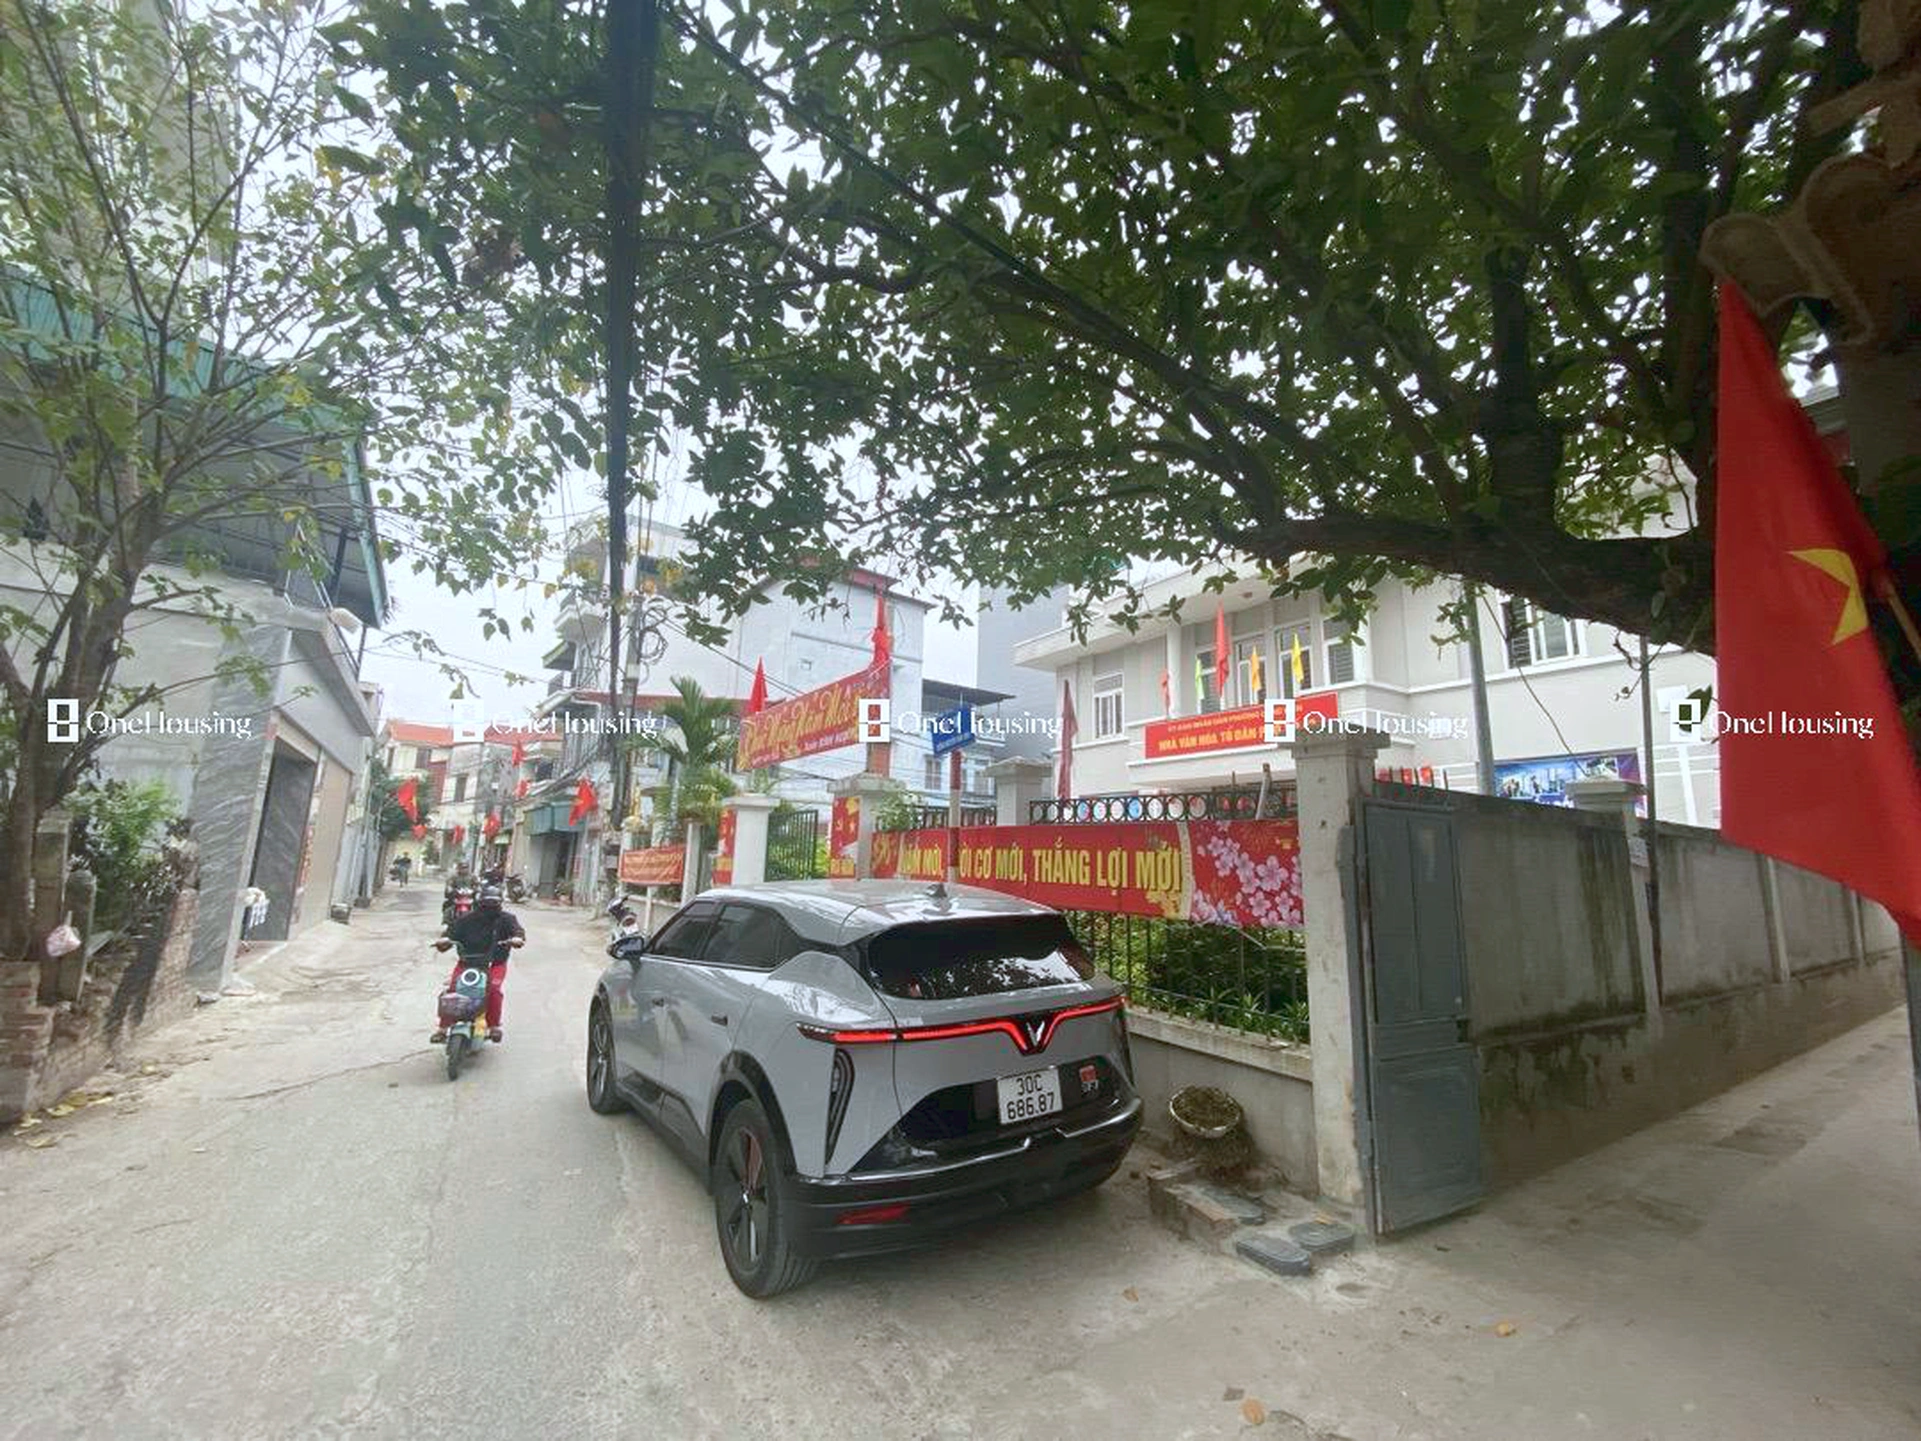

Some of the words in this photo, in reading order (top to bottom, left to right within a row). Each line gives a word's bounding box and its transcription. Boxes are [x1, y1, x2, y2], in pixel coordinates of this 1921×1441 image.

[975, 846, 994, 879] CƠ
[995, 841, 1028, 884] MỚI,
[1032, 836, 1091, 886] THẮNG
[1097, 846, 1128, 896] LỢI
[1136, 840, 1182, 892] MỚI
[1016, 1073, 1042, 1096] 30C
[1006, 1091, 1055, 1120] 686.87
